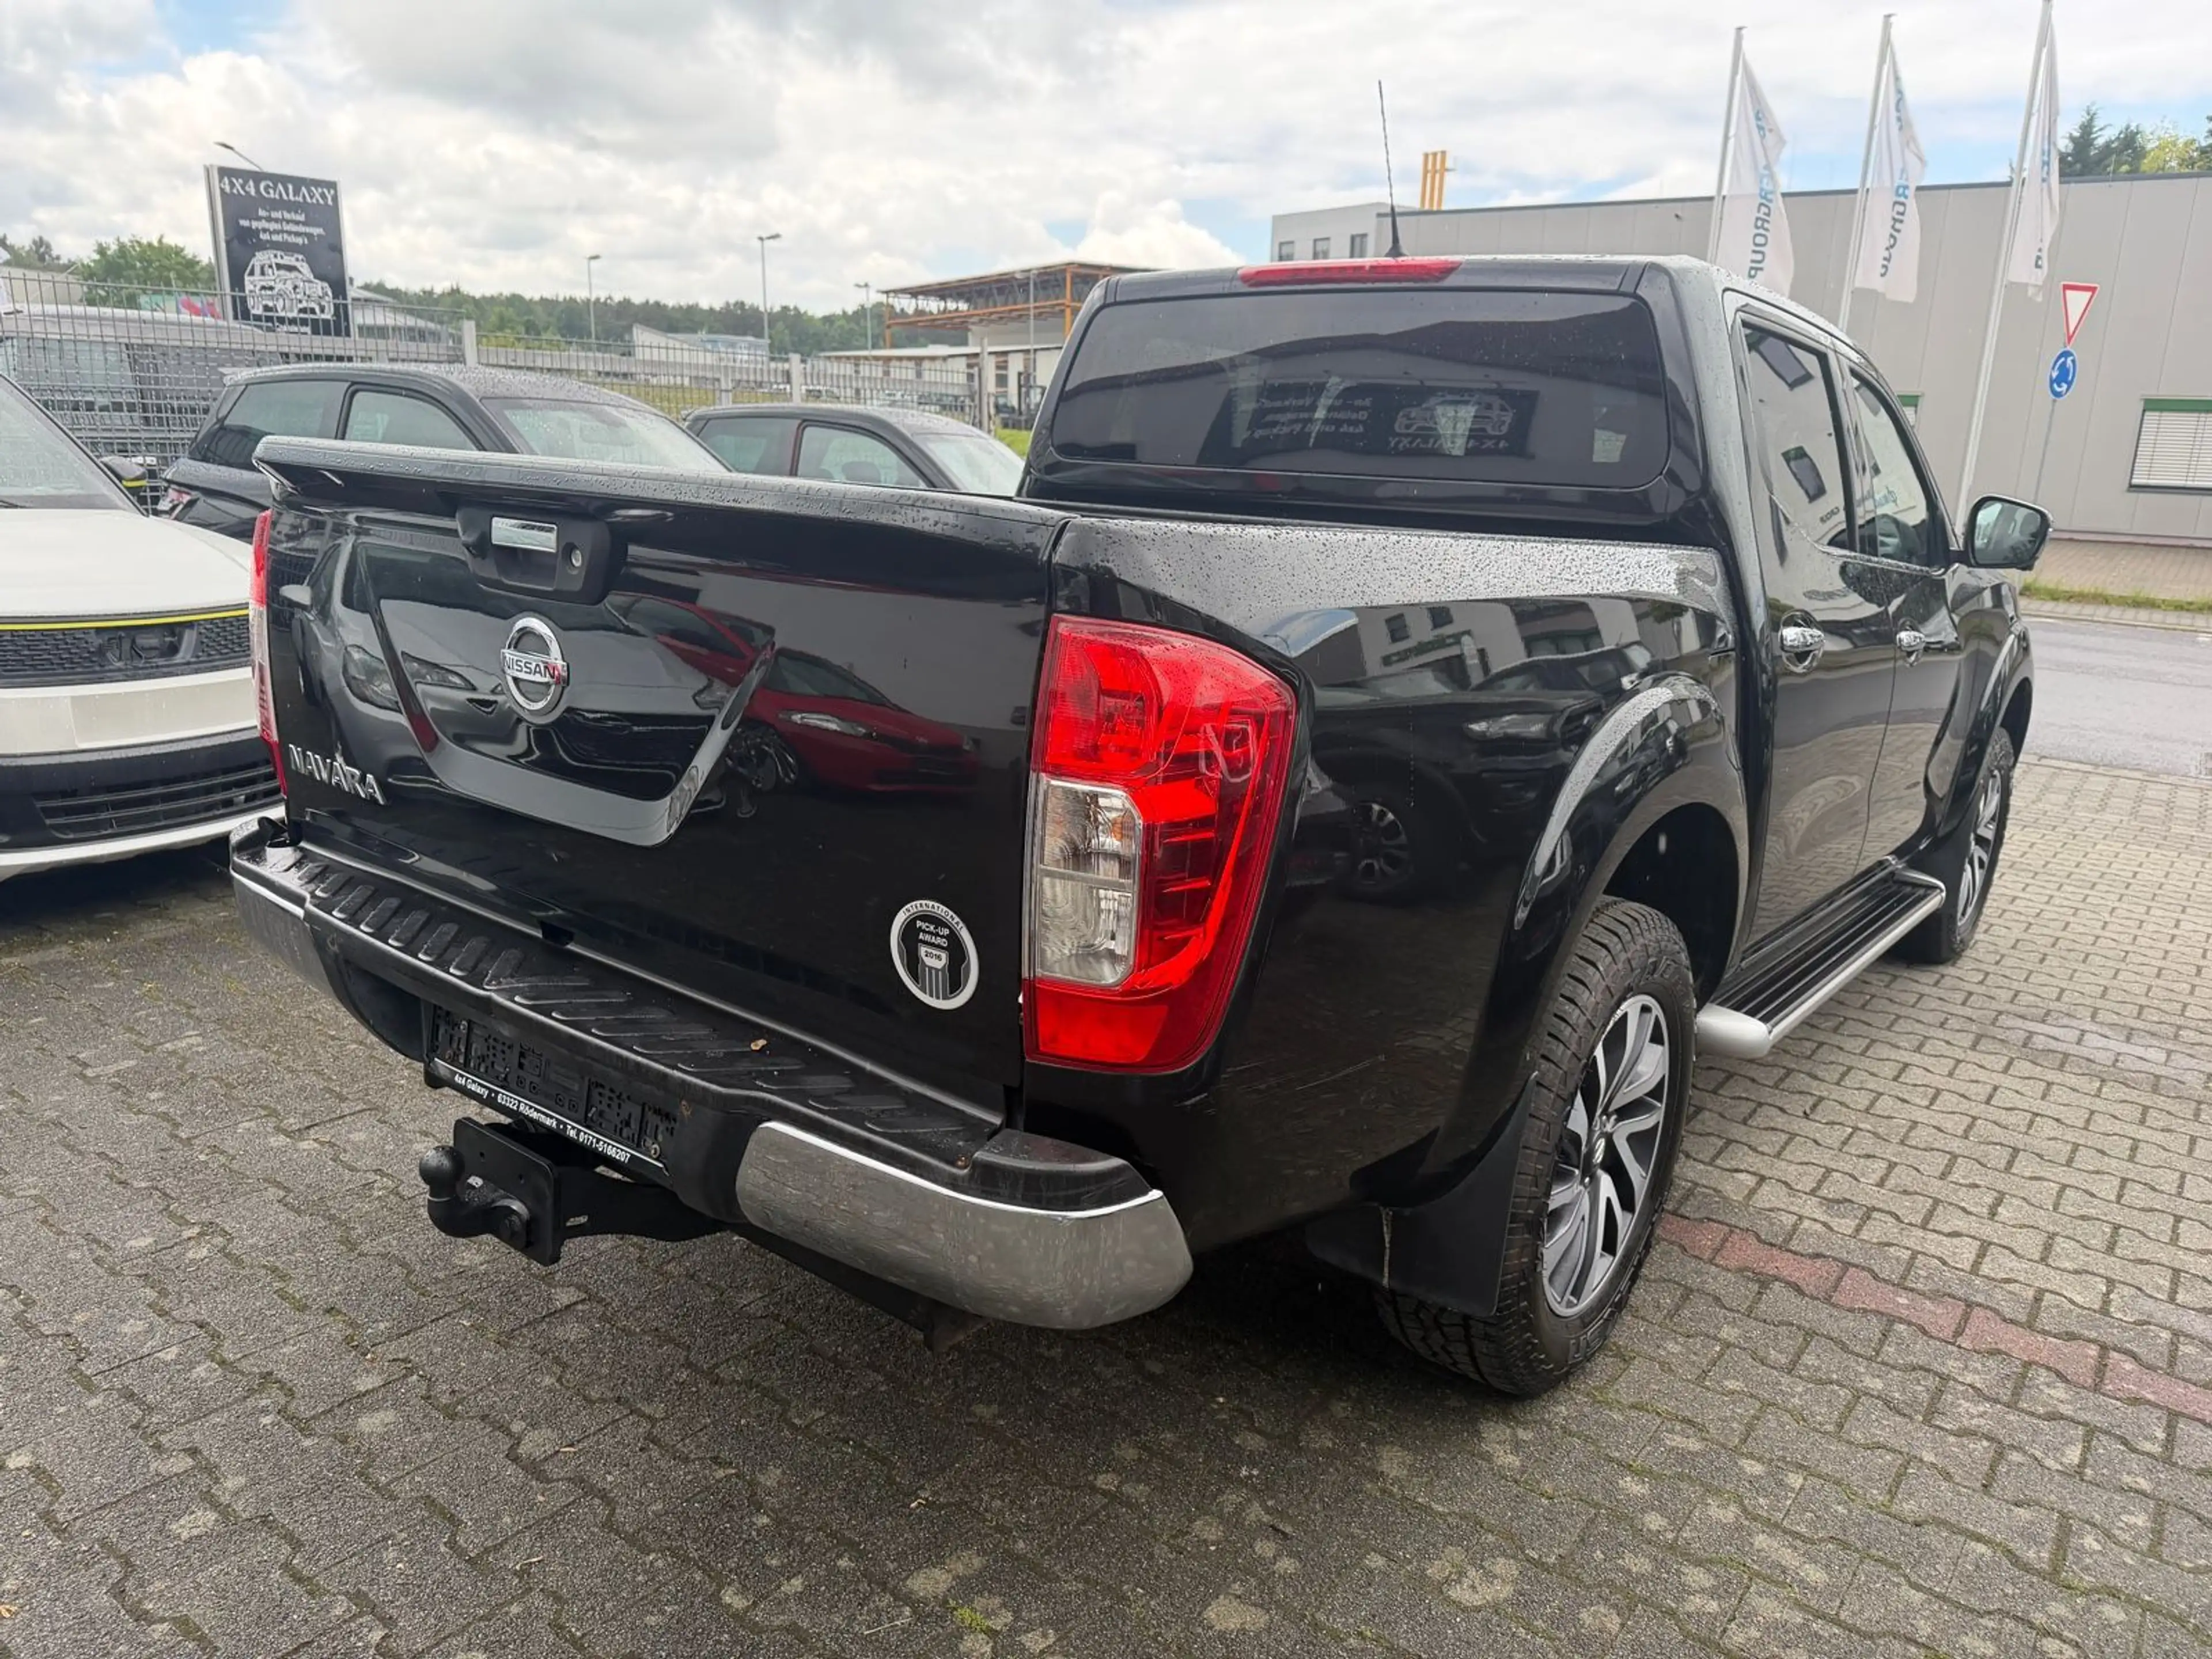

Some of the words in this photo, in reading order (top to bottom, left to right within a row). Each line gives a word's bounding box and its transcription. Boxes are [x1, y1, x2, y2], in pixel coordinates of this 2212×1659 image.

[219, 176, 256, 197] 4X4
[259, 180, 334, 206] GALAXY
[505, 656, 556, 680] NISSAN
[289, 743, 388, 805] NAVARA
[902, 902, 964, 932] INTERNATIONAL
[916, 920, 950, 937] PICK-UP
[918, 931, 948, 948] AWARD
[924, 949, 942, 962] 2016
[454, 1073, 466, 1086] 4x4
[466, 1079, 489, 1099] Galaxy
[497, 1093, 518, 1111] 63322
[519, 1102, 558, 1129] Rödermark
[566, 1124, 578, 1140] Tel.
